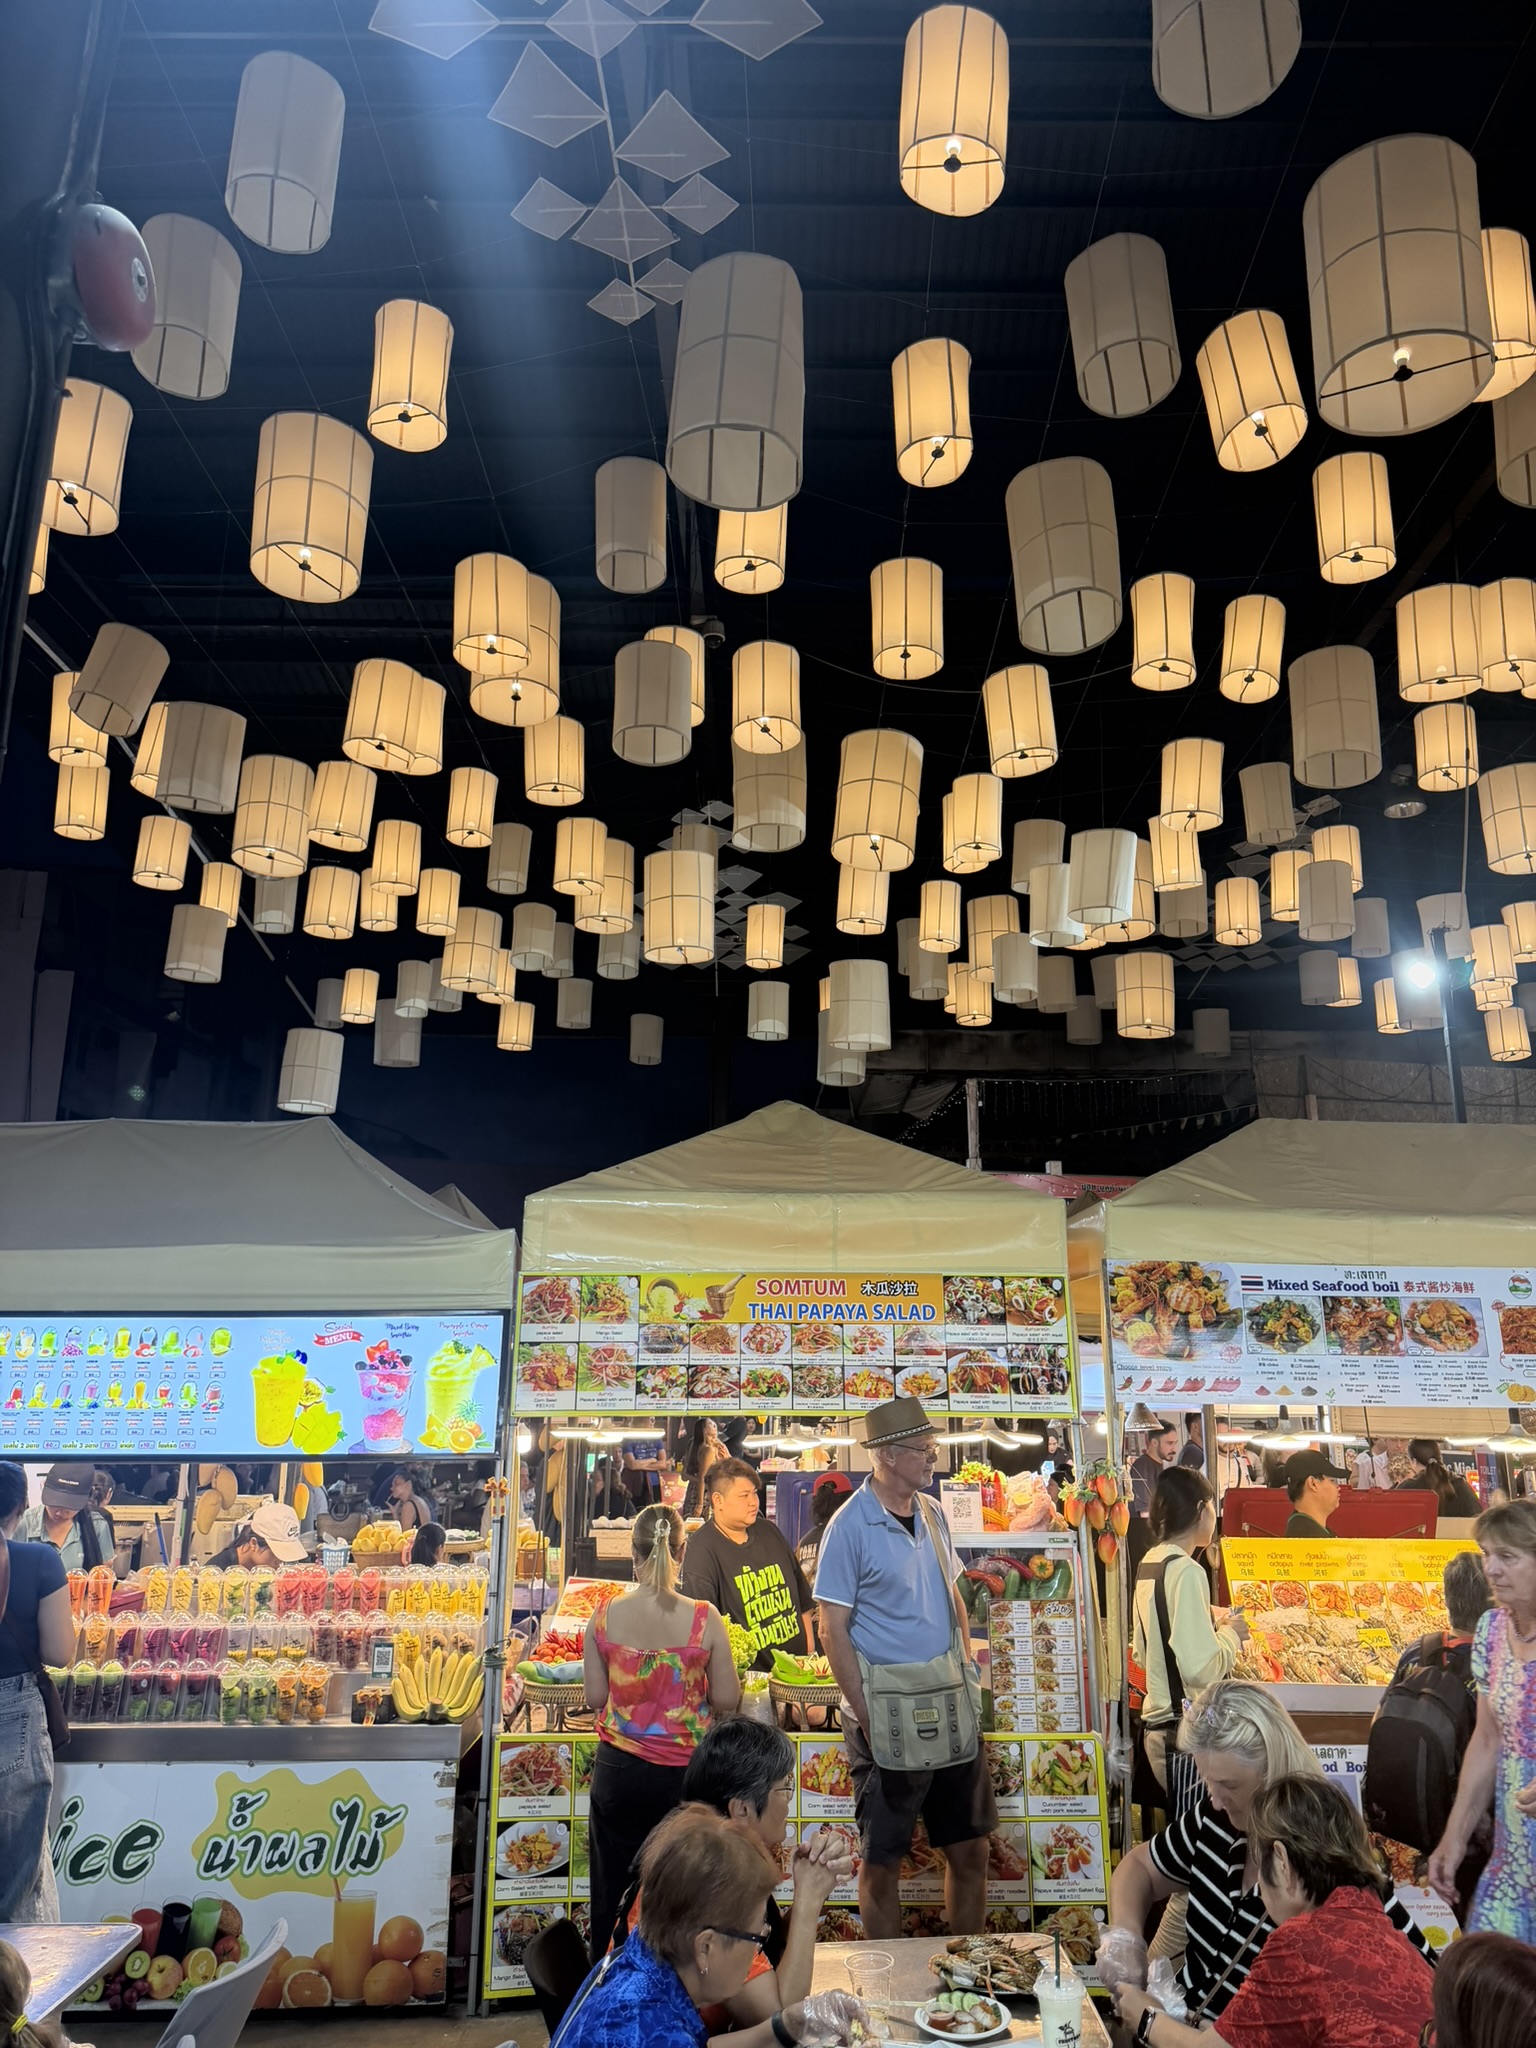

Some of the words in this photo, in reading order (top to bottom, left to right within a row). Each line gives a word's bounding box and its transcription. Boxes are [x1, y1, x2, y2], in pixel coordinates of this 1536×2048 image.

[756, 1279, 847, 1296] SOMTUM
[861, 1280, 919, 1297] 木瓜沙拉
[1267, 1279, 1309, 1292] Mixed
[1312, 1280, 1369, 1292] Seafood
[1373, 1281, 1400, 1292] boil
[1403, 1281, 1475, 1294] 泰式酱炒海鲜
[748, 1303, 793, 1320] THAI
[798, 1303, 868, 1321] PAPAYA
[872, 1303, 937, 1322] SALAD
[324, 1321, 353, 1334] Special
[324, 1332, 353, 1346] MENU
[1480, 1465, 1496, 1475] TOILET
[1269, 1560, 1293, 1568] octopus
[1322, 1761, 1338, 1773] od
[201, 1794, 404, 1876] น้ำผลไม้
